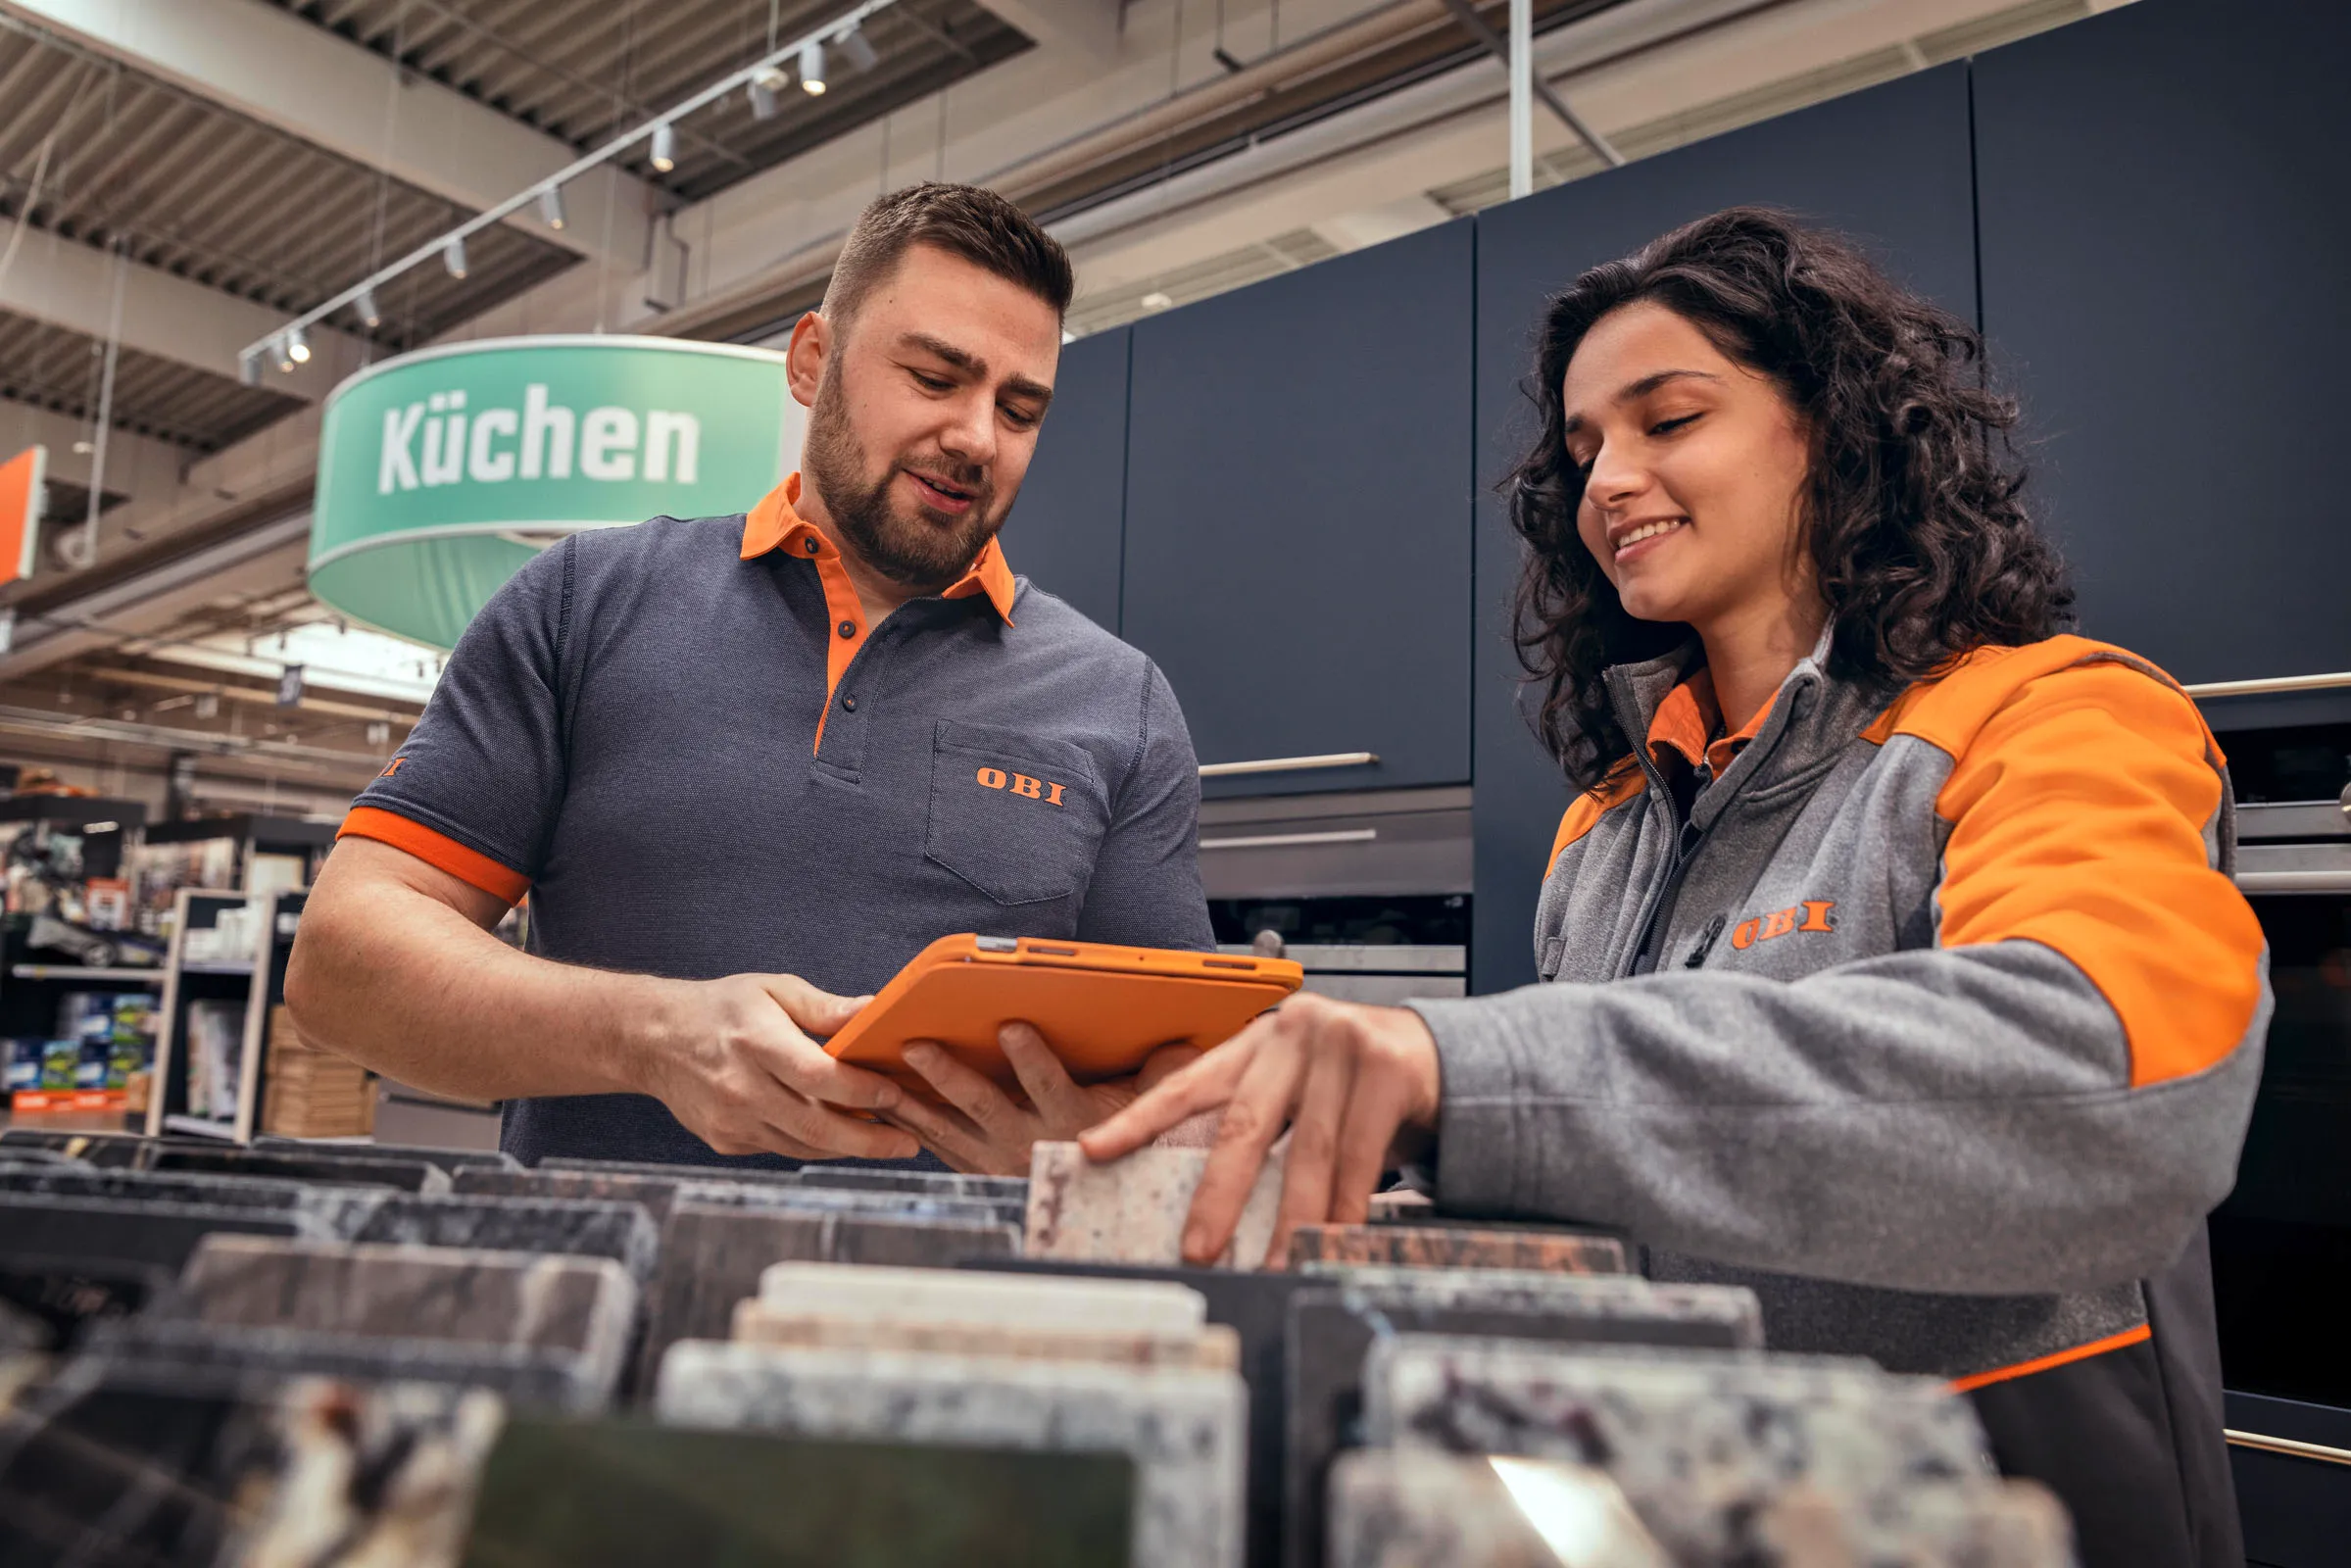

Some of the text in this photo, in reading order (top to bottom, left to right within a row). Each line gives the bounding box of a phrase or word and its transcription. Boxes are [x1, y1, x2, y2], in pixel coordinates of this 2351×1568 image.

[378, 383, 700, 495] Küchen
[976, 766, 1067, 807] OBI
[1732, 901, 1836, 950] OBI
